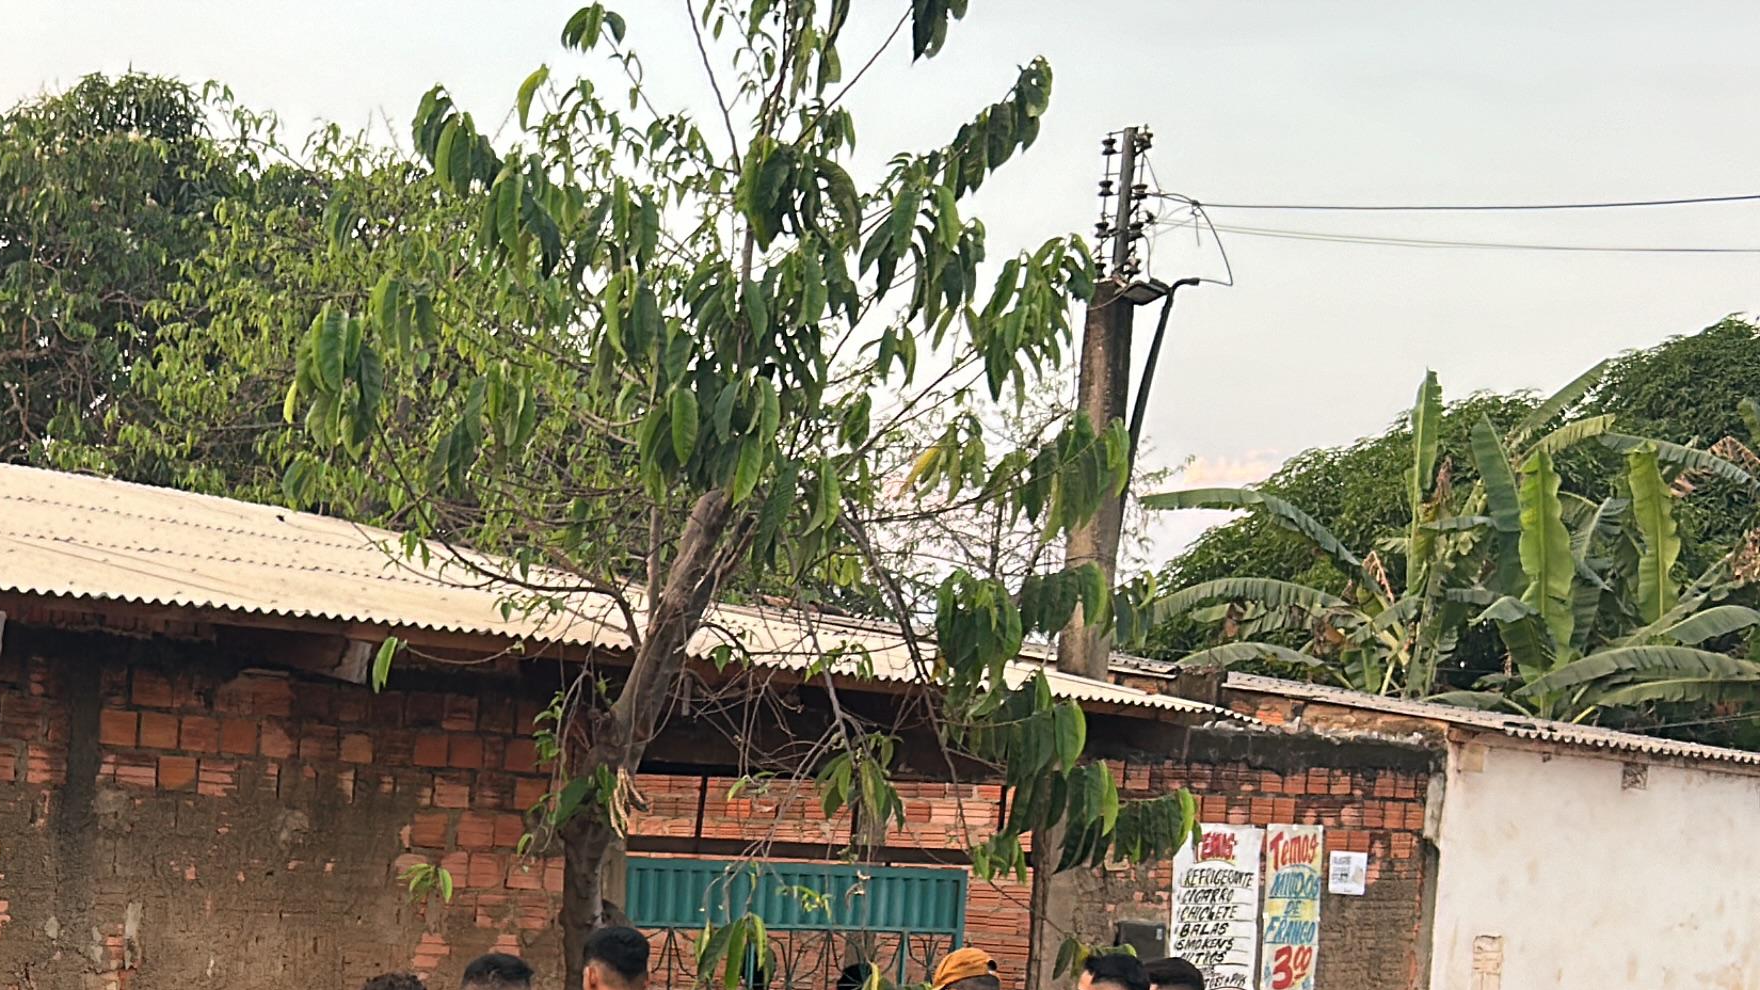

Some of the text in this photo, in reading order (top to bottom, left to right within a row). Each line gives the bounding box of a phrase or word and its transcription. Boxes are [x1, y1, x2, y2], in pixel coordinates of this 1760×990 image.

[1182, 888, 1234, 903] CIGARRO
[1180, 906, 1238, 921] CHICLETE
[1284, 901, 1301, 915] DE
[1179, 923, 1229, 938] BALAS
[1264, 917, 1315, 944] FRANGO
